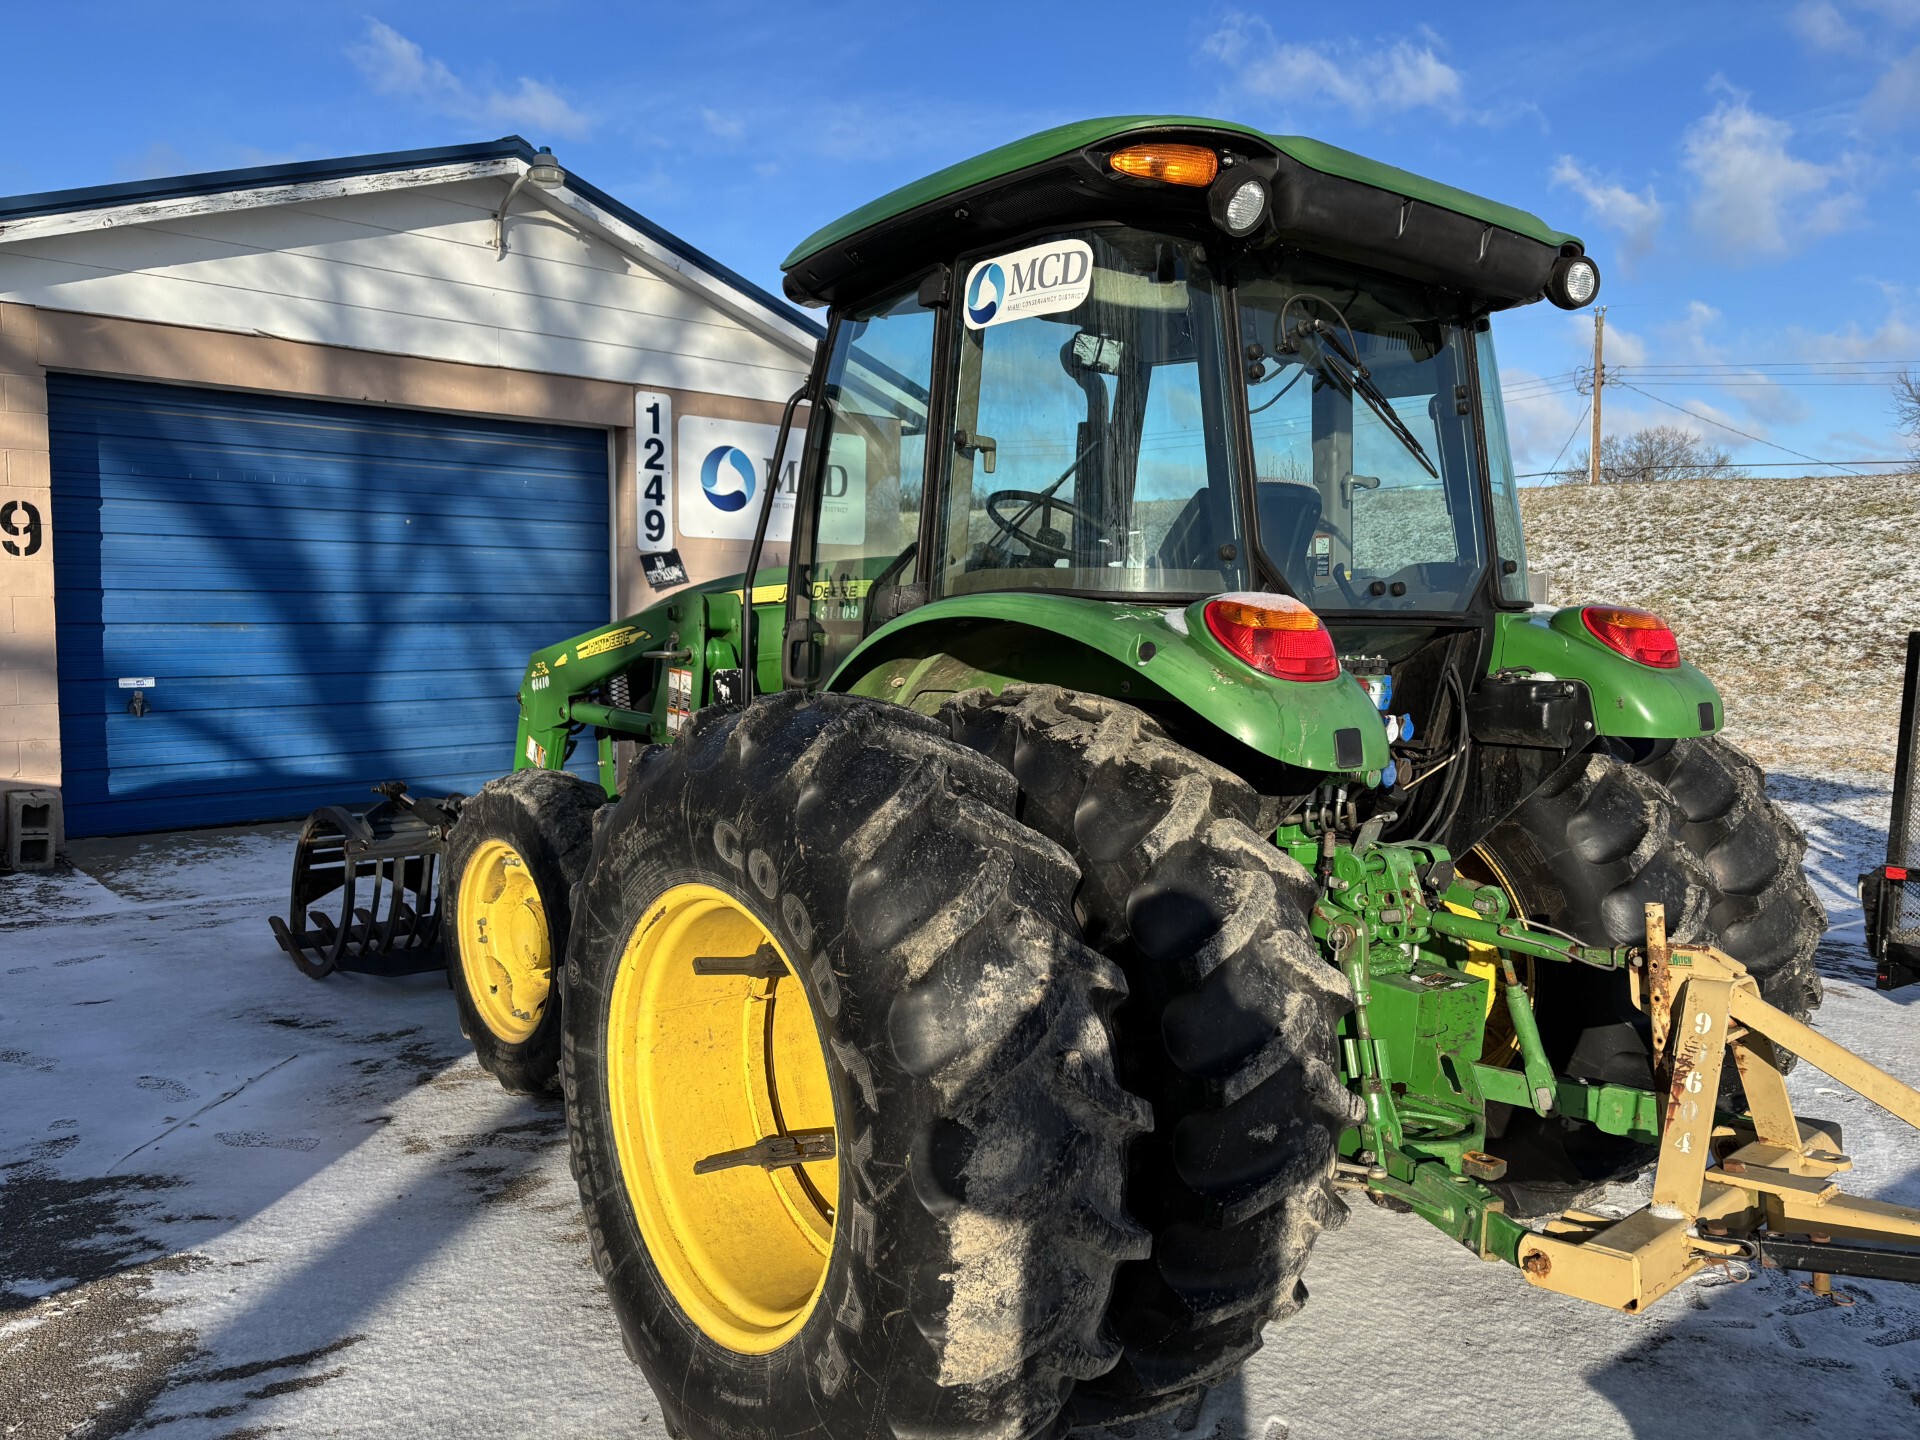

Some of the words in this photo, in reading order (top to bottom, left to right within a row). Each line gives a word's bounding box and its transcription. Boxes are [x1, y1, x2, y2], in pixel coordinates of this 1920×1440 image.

[1008, 251, 1088, 296] MCD
[1007, 302, 1021, 311] MIAMI
[1022, 296, 1057, 308] CONSERVANCY
[1058, 292, 1085, 301] DISTRICT
[644, 403, 665, 542] 1249
[763, 457, 848, 498] MD
[0, 500, 42, 556] 9
[586, 640, 605, 655] JOHN
[605, 631, 630, 649] DEERE
